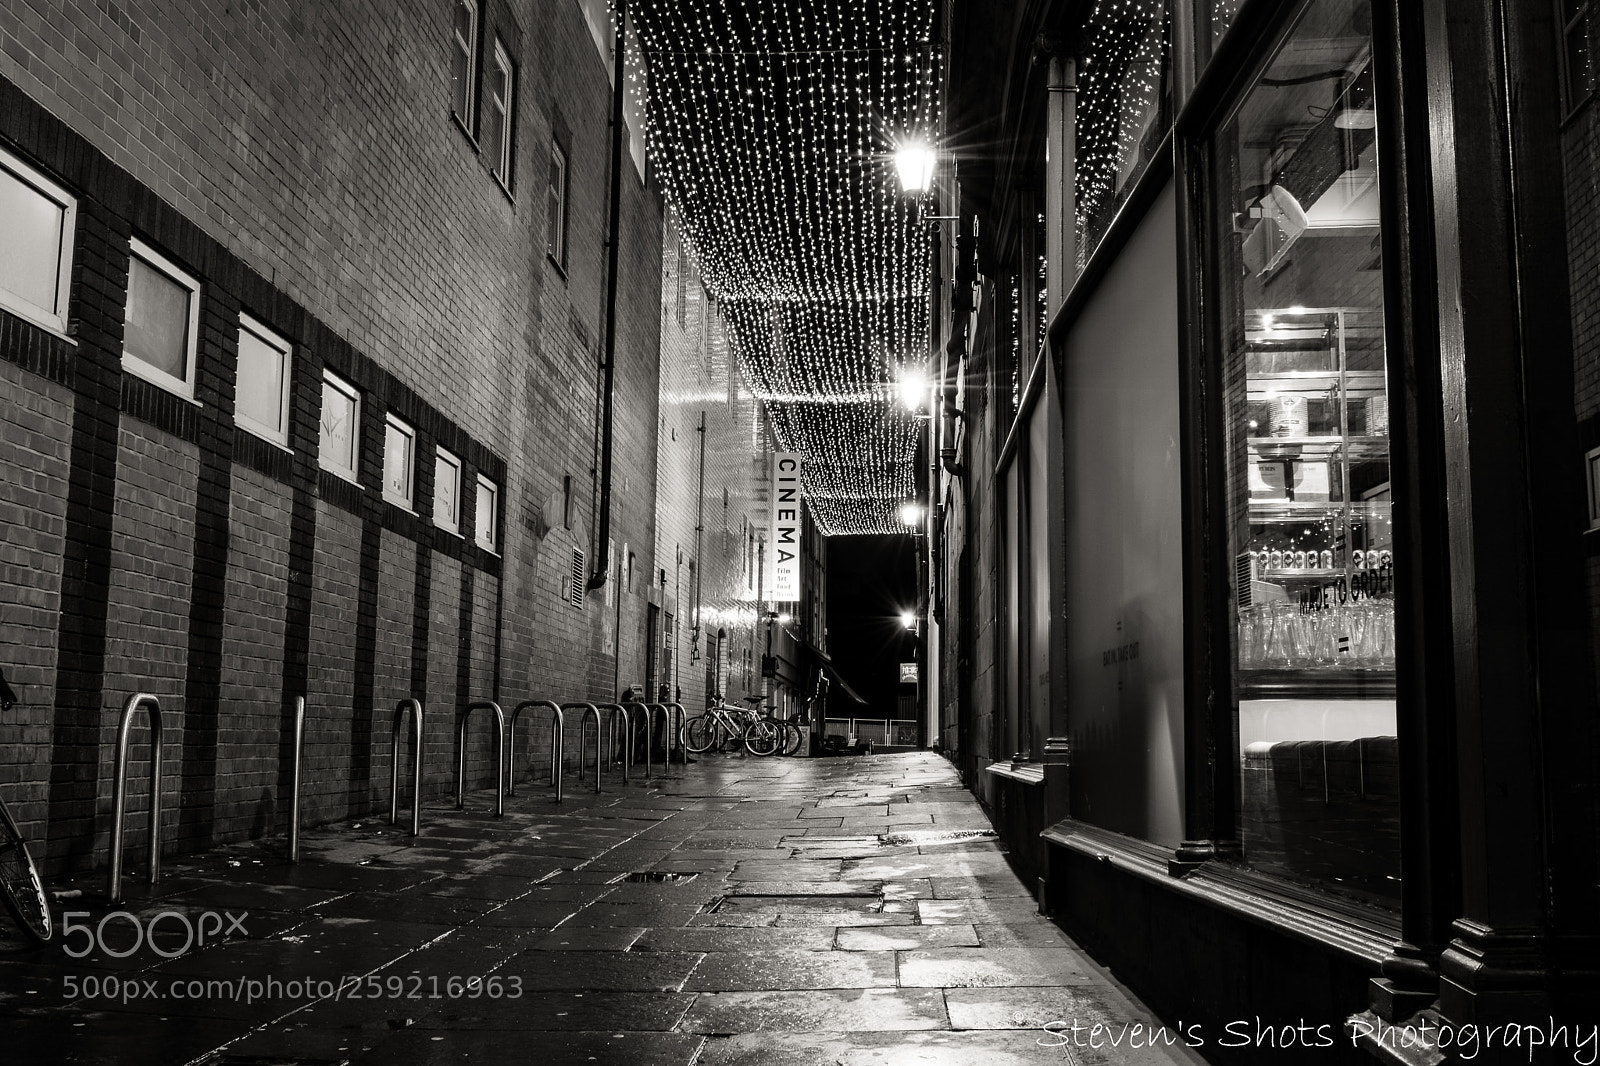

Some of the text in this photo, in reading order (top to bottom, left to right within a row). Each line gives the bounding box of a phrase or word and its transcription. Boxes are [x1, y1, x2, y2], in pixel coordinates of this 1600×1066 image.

[778, 458, 796, 563] CINEMA
[1299, 582, 1330, 616] MADE
[1331, 577, 1347, 606] TO
